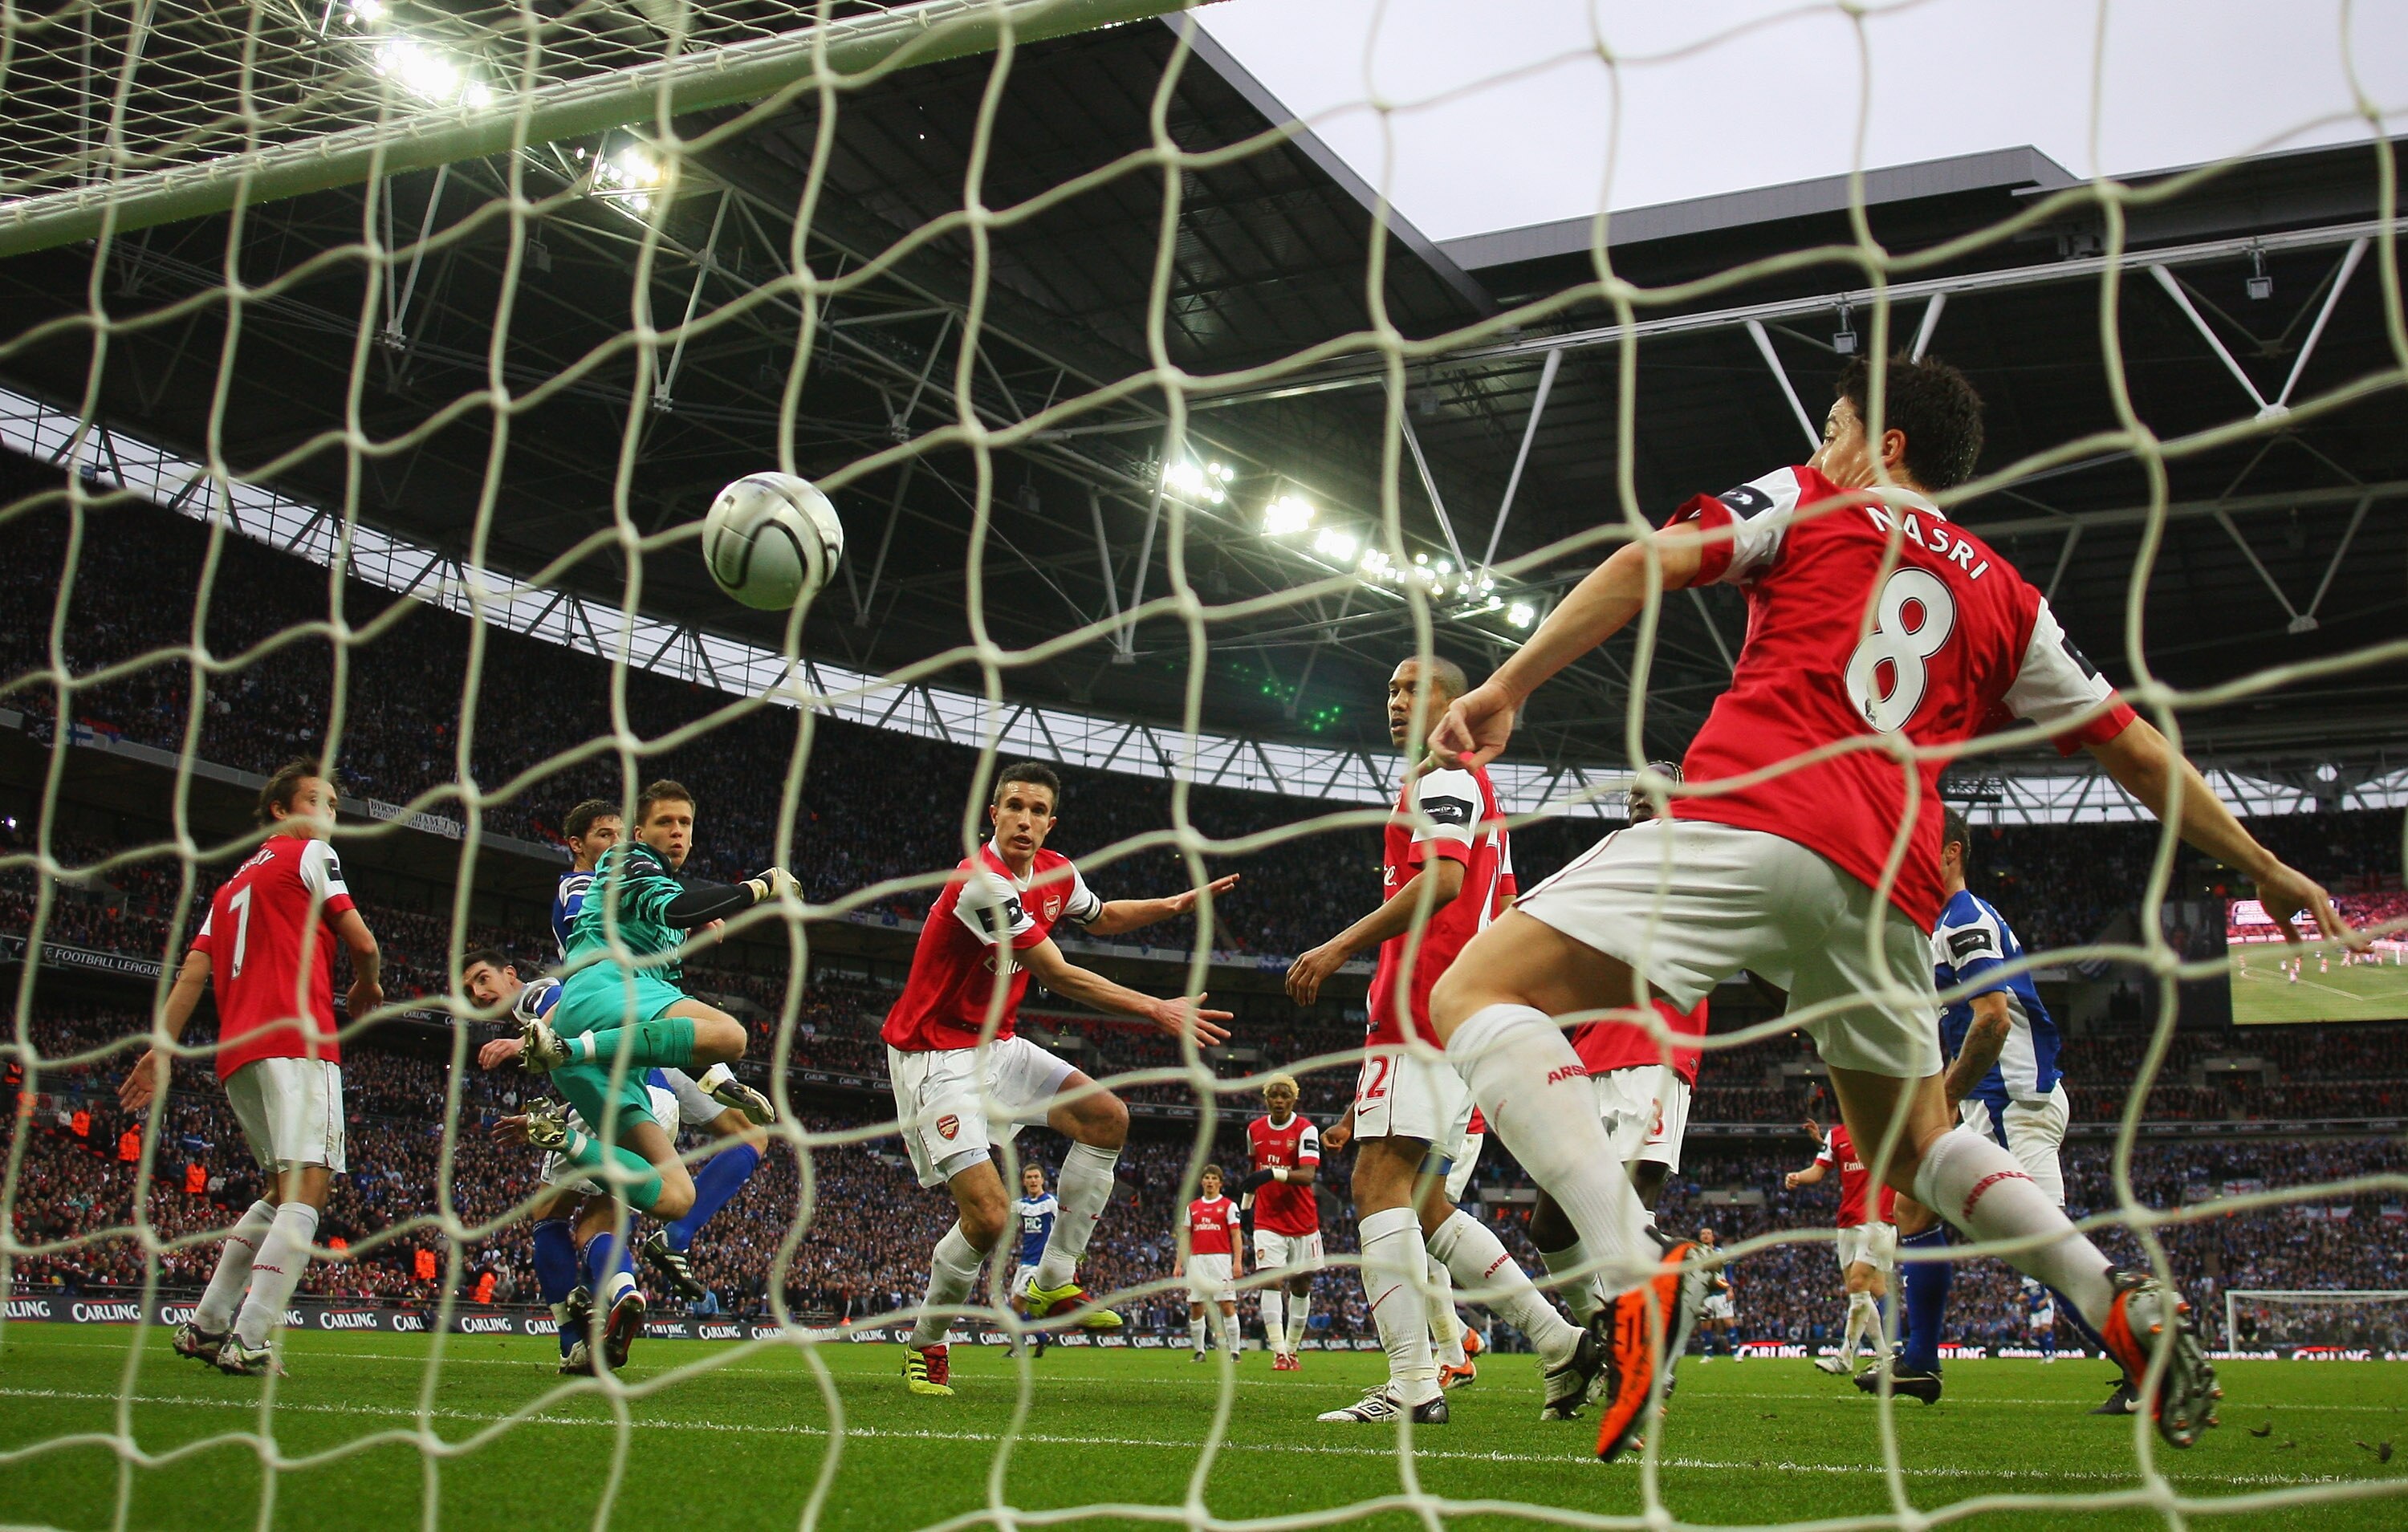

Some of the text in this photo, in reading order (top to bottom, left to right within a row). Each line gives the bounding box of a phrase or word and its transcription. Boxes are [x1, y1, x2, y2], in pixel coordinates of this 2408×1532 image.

[1865, 505, 1989, 580] NASRI
[1845, 567, 1957, 734] 8
[55, 948, 115, 969] FOOTBALL
[118, 960, 161, 977] LEAGUE
[804, 1072, 828, 1081] CARLING
[72, 1302, 141, 1323] CARLING
[320, 1312, 377, 1330] CARLING
[461, 1317, 512, 1334] CARLING
[698, 1325, 741, 1340] CARLING
[850, 1328, 886, 1343] CARLING
[1059, 1334, 1091, 1347] CARLING
[1738, 1345, 1807, 1358] CARLING
